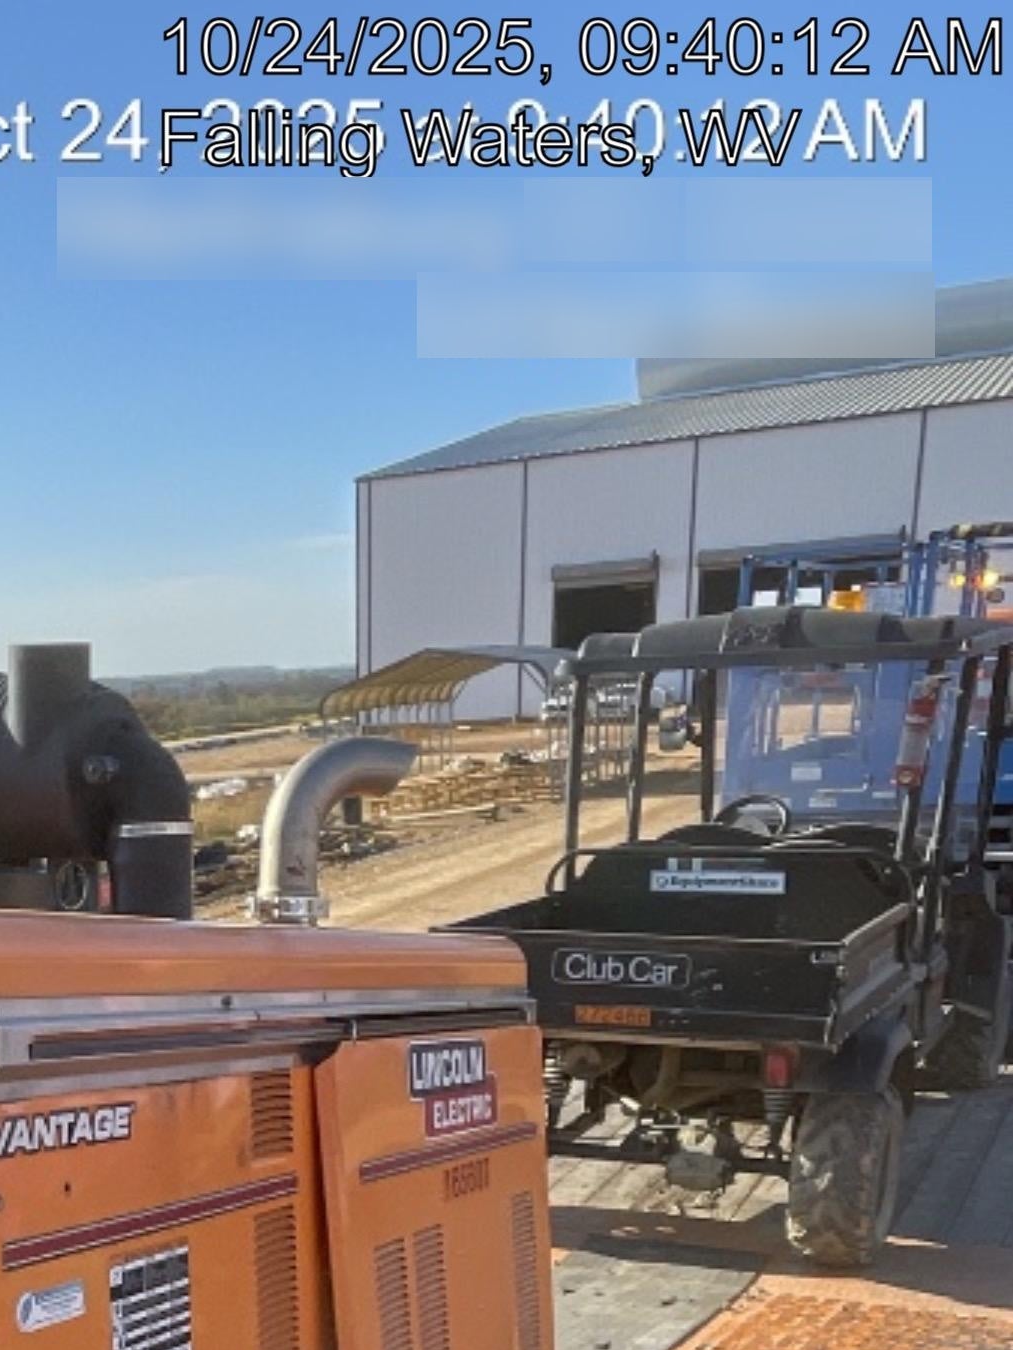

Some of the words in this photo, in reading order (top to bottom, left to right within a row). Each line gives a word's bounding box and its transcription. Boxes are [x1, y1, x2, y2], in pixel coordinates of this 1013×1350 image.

[564, 952, 625, 982] Club
[628, 955, 679, 985] Car
[412, 1046, 484, 1090] LINCOLN
[433, 1094, 493, 1129] ELECTRIC
